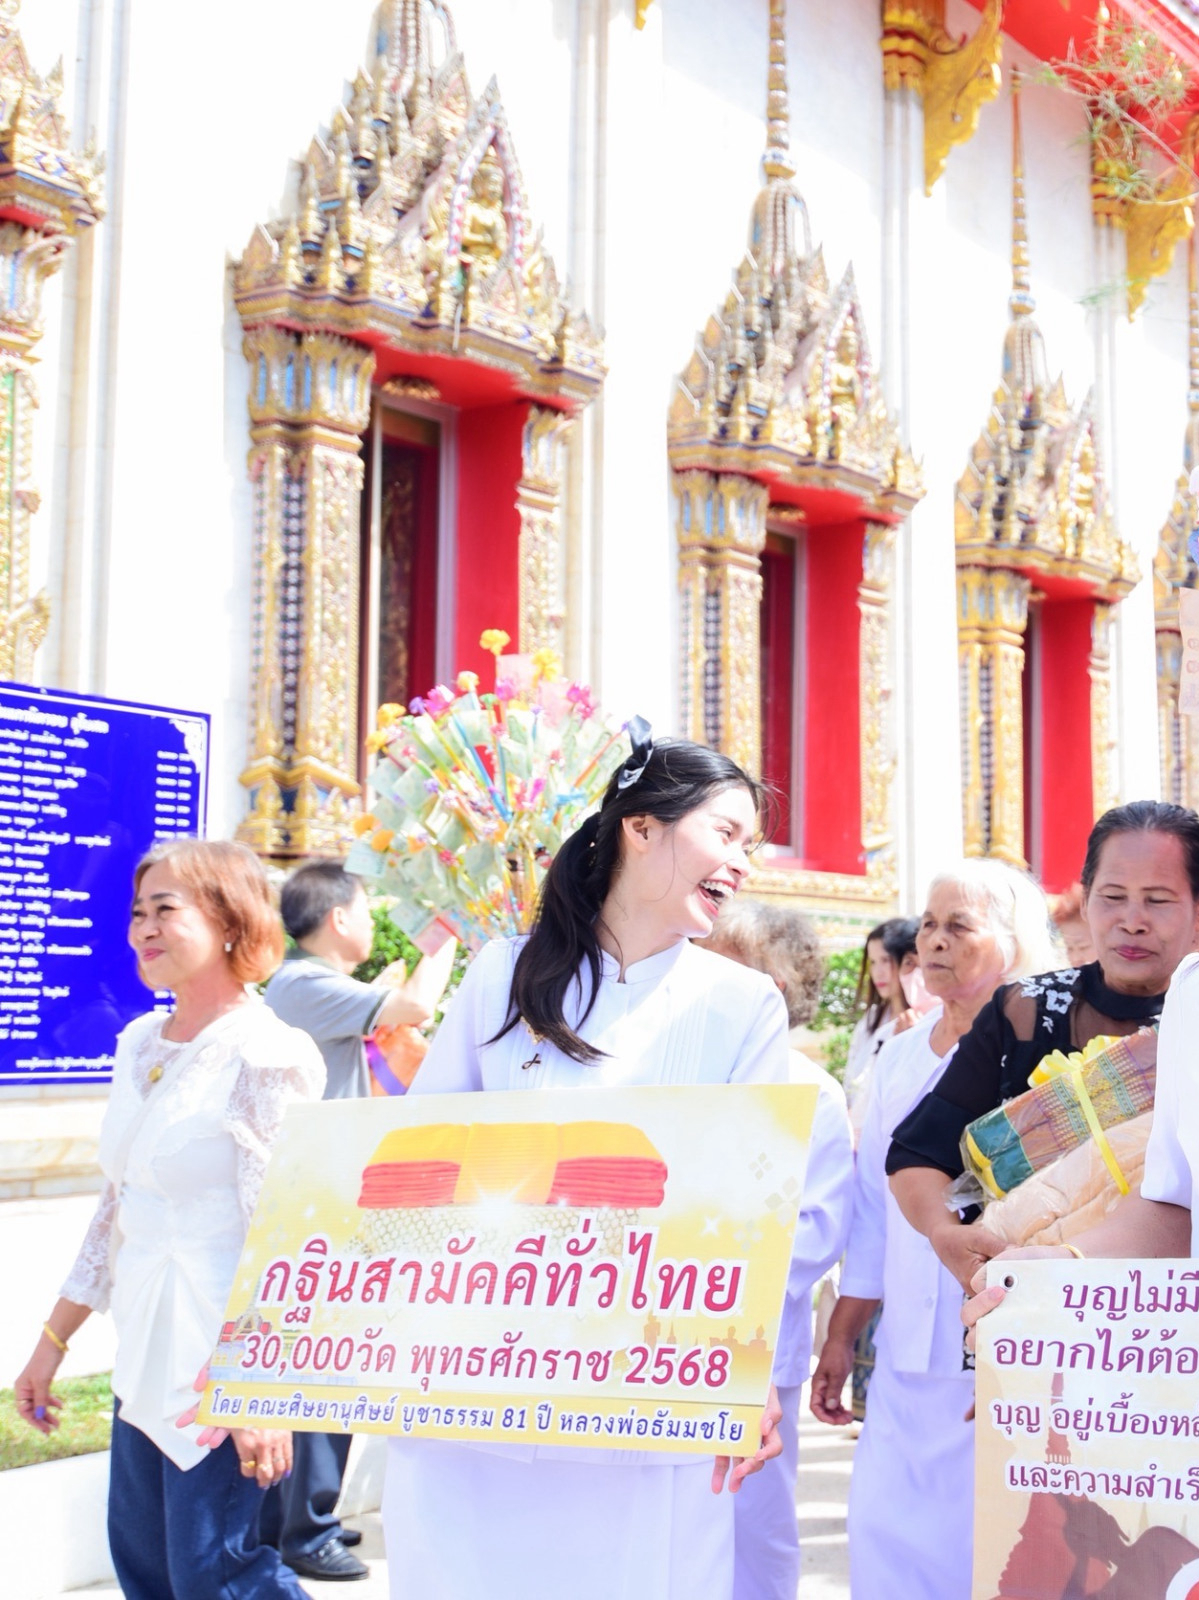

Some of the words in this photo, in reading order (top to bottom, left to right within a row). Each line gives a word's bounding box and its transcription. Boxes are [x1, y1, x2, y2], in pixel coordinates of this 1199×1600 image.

[261, 1219, 742, 1324] กฐินสามัคคีทั่วไทย
[239, 1326, 395, 1380] 30,000วัด
[411, 1331, 613, 1392] พุทธศักราช
[625, 1346, 729, 1388] 2568
[211, 1388, 242, 1414] โดย
[248, 1393, 398, 1428] คณะศิษยานุศิษย์
[402, 1405, 494, 1432] บูชาธรรม
[501, 1408, 526, 1429] 81
[537, 1404, 552, 1431] ปี
[560, 1409, 743, 1442] หลวงพ่อธัมมชโย
[993, 1402, 1041, 1434] บุญ
